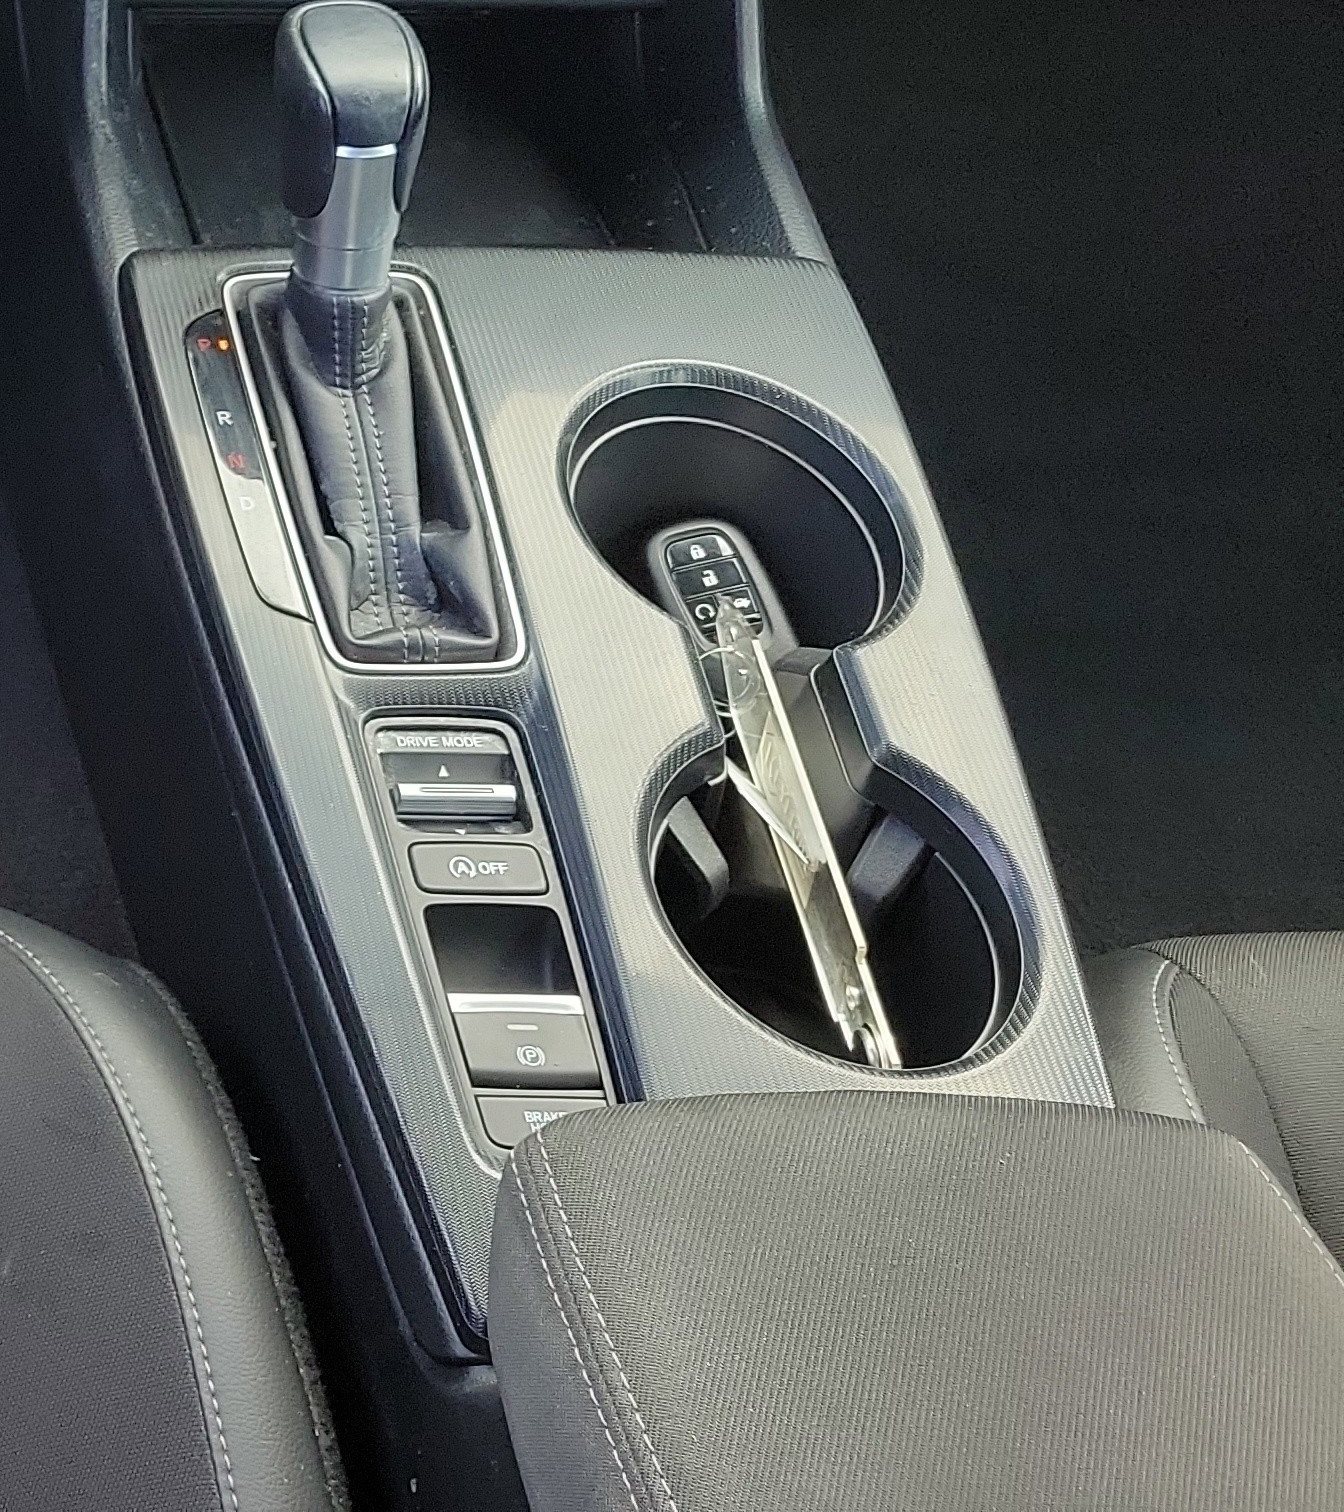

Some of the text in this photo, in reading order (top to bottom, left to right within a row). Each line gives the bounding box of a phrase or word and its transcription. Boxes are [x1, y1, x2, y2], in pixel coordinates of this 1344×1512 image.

[197, 338, 212, 352] P
[216, 410, 234, 426] R
[227, 454, 245, 469] N
[239, 495, 256, 511] D
[396, 736, 484, 748] DRIVE MODE
[478, 862, 509, 875] OFF
